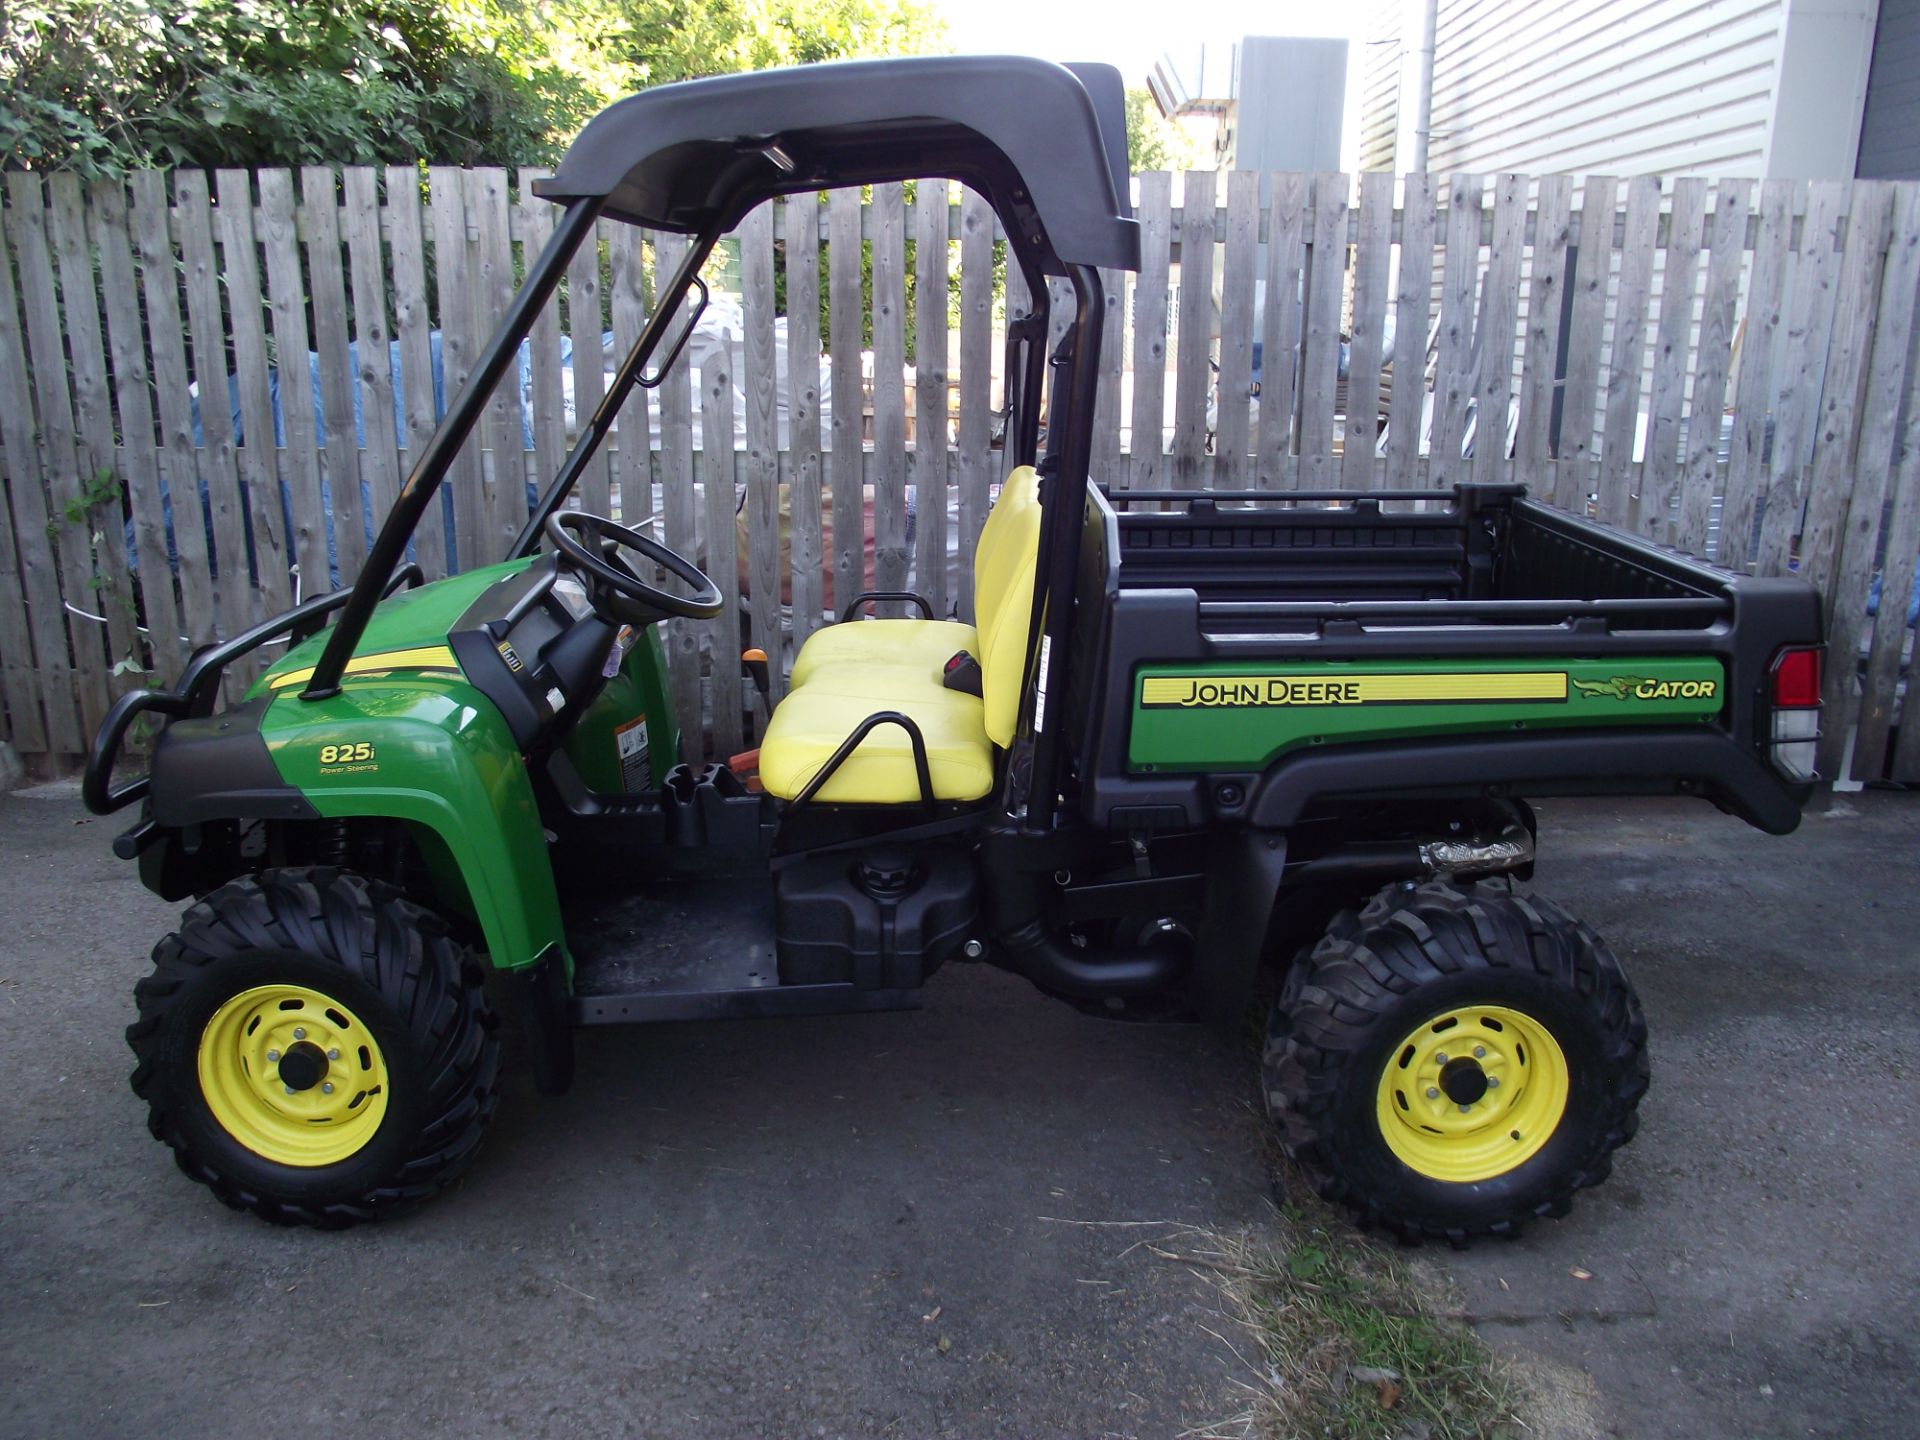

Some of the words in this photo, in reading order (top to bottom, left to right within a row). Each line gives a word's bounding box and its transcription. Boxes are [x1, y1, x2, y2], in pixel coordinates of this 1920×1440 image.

[1182, 681, 1260, 703] JOHN
[1267, 680, 1361, 702] DEERE
[1635, 679, 1716, 699] GATOR
[320, 742, 376, 764] 825i
